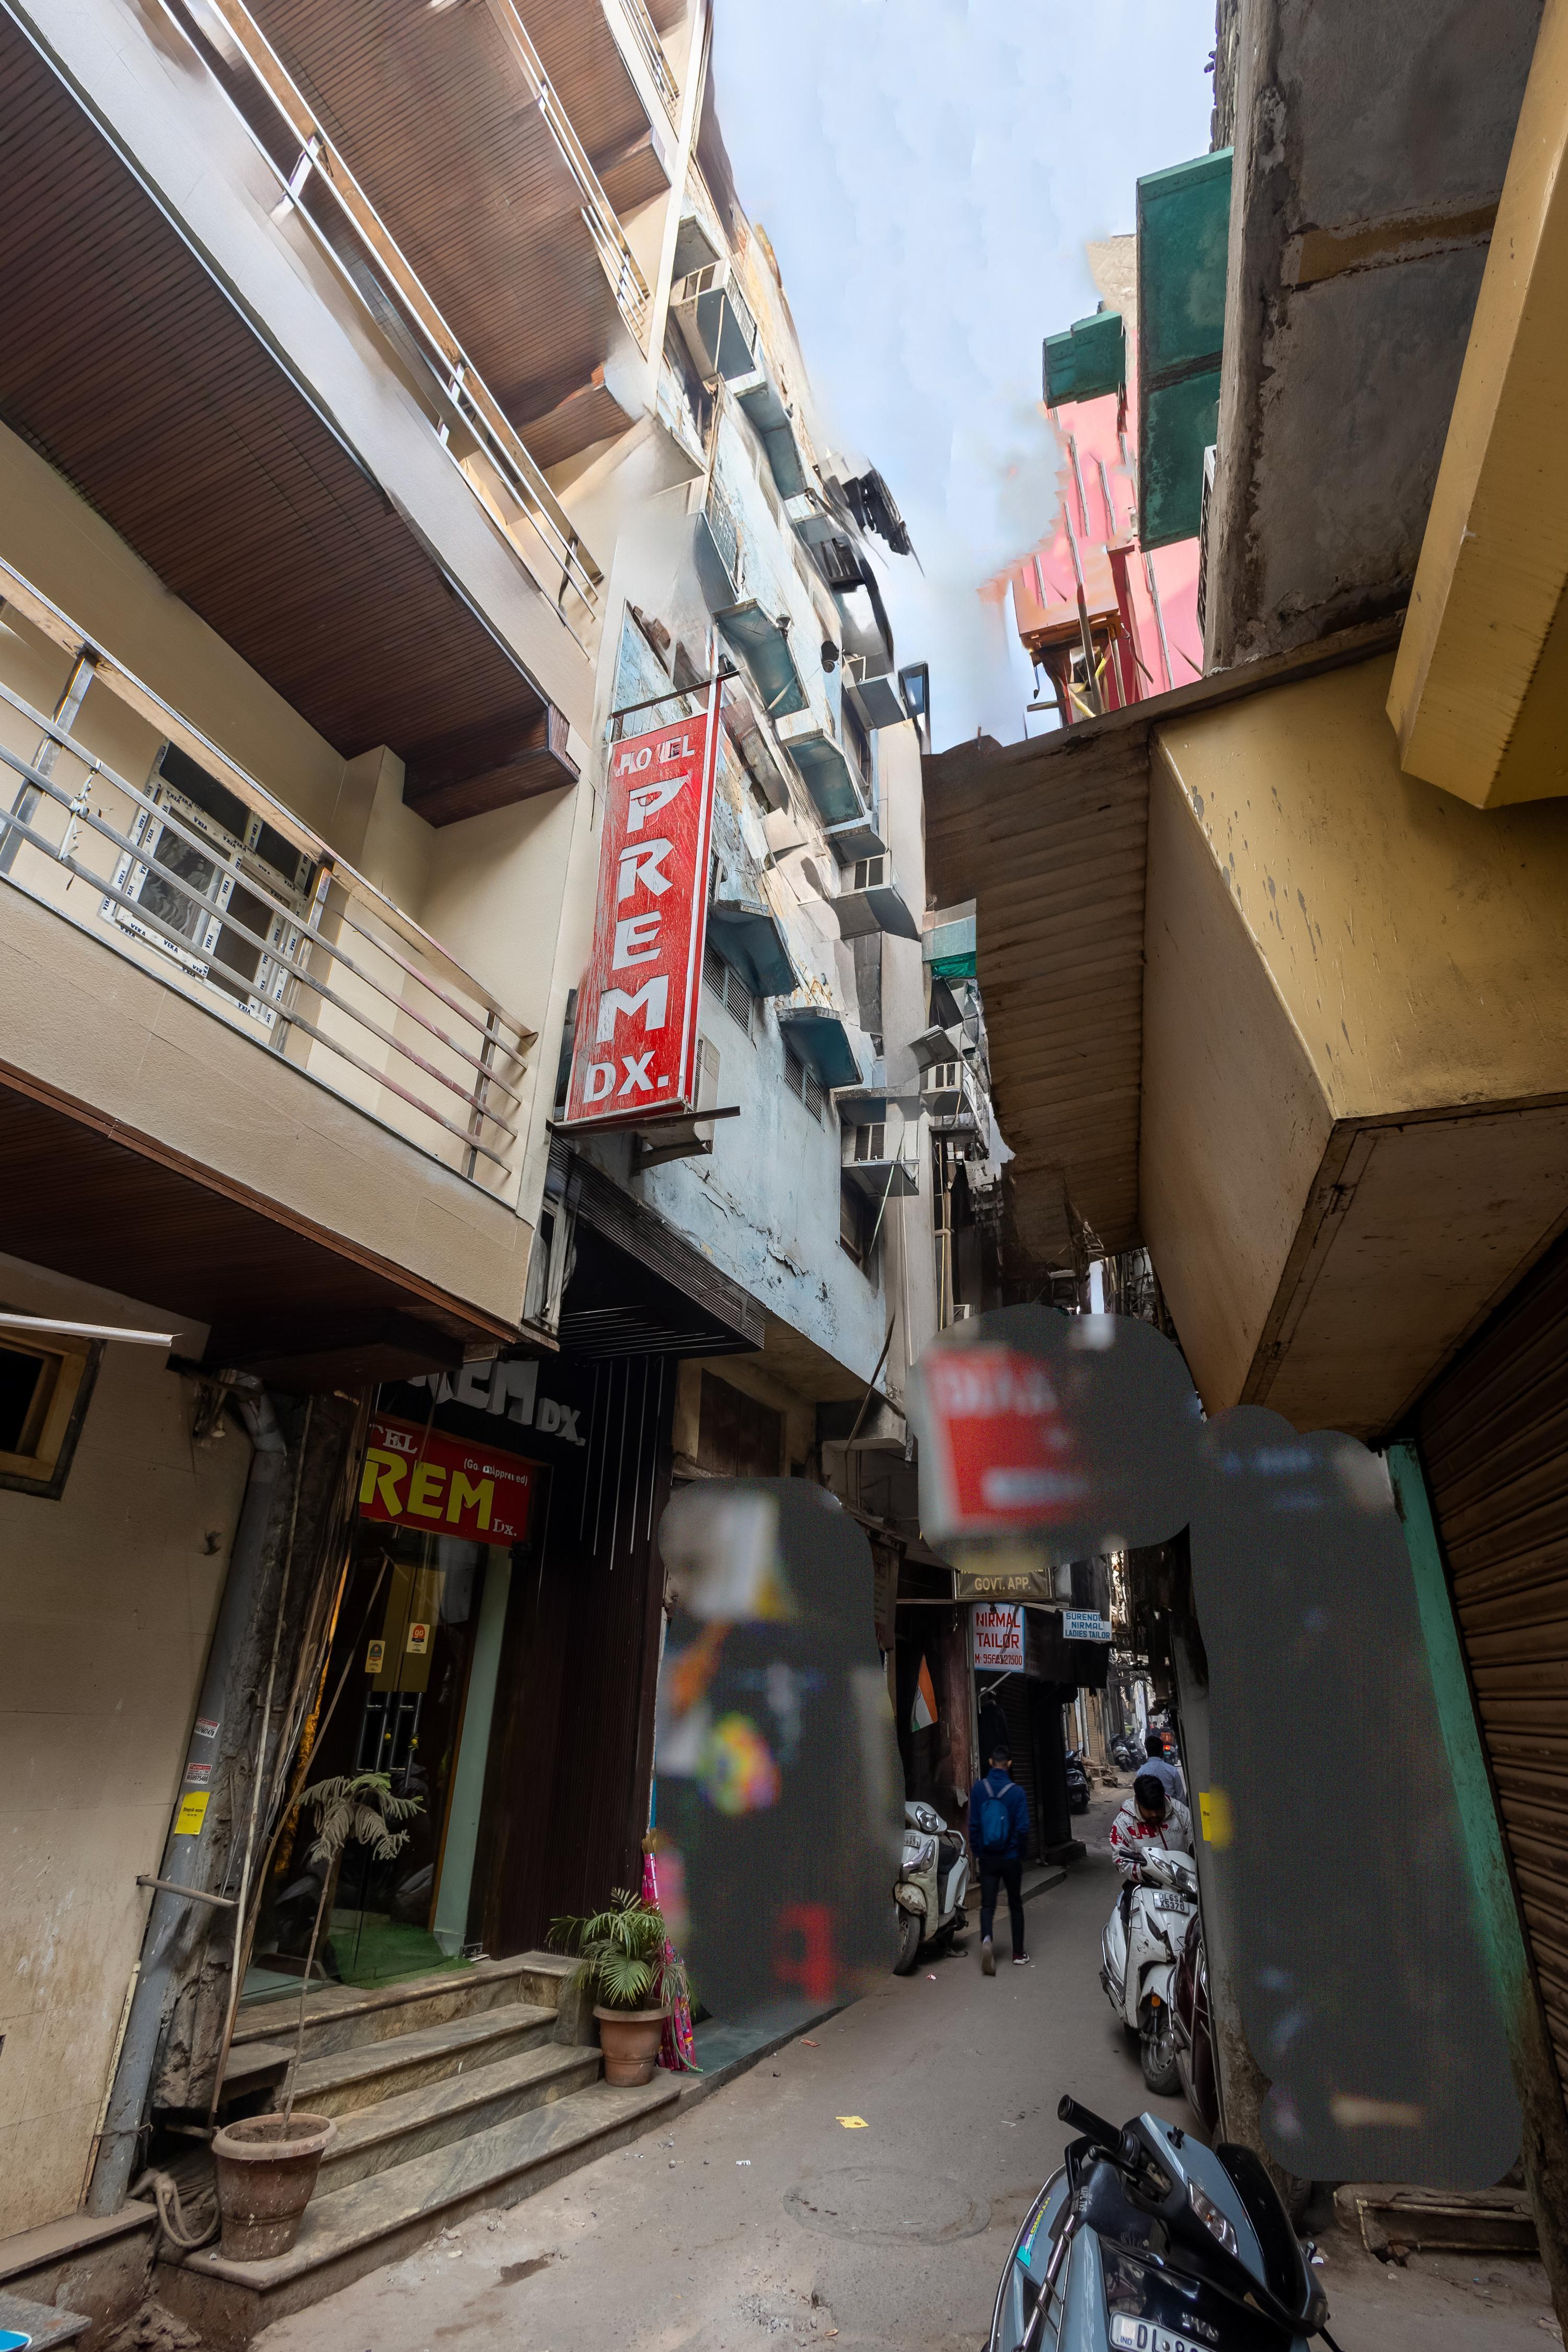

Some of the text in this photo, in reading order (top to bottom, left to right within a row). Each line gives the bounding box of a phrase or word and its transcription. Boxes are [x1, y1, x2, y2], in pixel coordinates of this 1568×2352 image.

[194, 815, 207, 831] VEKA
[140, 864, 148, 875] EKA
[595, 773, 688, 1043] PREM
[164, 939, 178, 953] VEKA
[205, 934, 213, 949] VEKA
[192, 964, 203, 974] VEK
[238, 1002, 250, 1014] VEKA
[583, 1049, 670, 1104] DX.
[536, 1398, 586, 1446] DX.
[975, 1576, 1031, 1591] GOVT. APP.
[976, 1612, 1021, 1628] NIRMAL
[1071, 1621, 1104, 1630] NIRMAL
[414, 1630, 423, 1638] go
[976, 1632, 1020, 1649] TAILOR
[1088, 1631, 1110, 1639] TAILOR
[1121, 2336, 1132, 2346] IND
